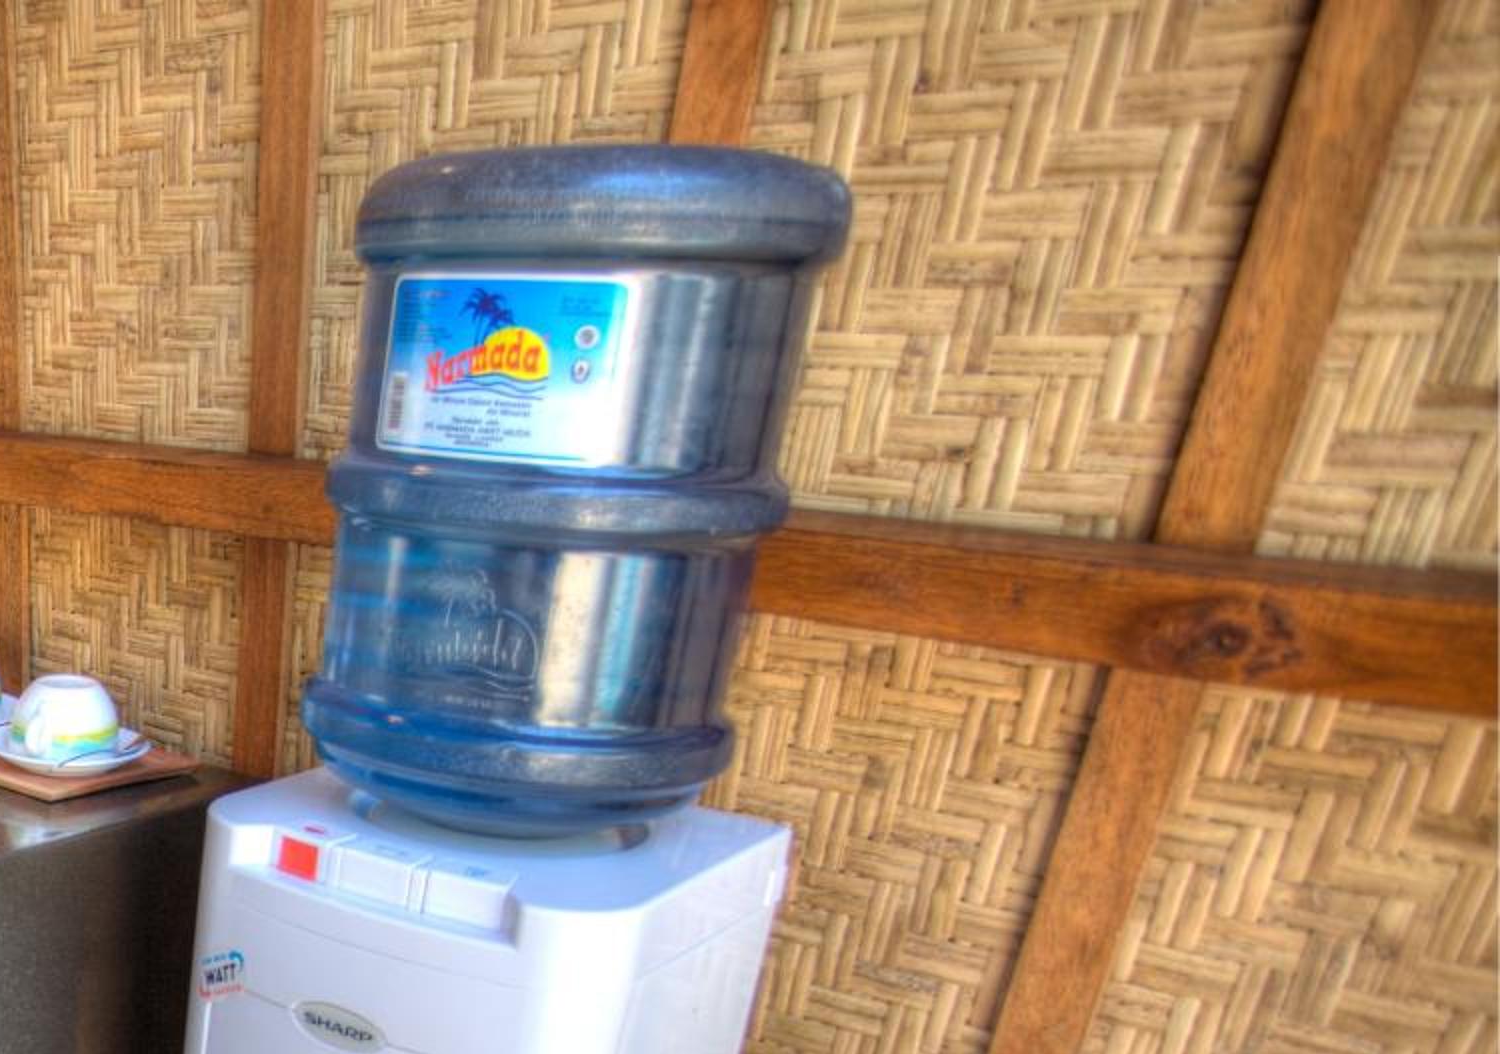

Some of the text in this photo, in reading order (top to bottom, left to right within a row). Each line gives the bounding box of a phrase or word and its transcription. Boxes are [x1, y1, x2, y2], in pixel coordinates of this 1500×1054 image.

[424, 326, 542, 394] Narmada
[204, 963, 236, 985] WATT
[303, 1011, 375, 1041] SHARP
